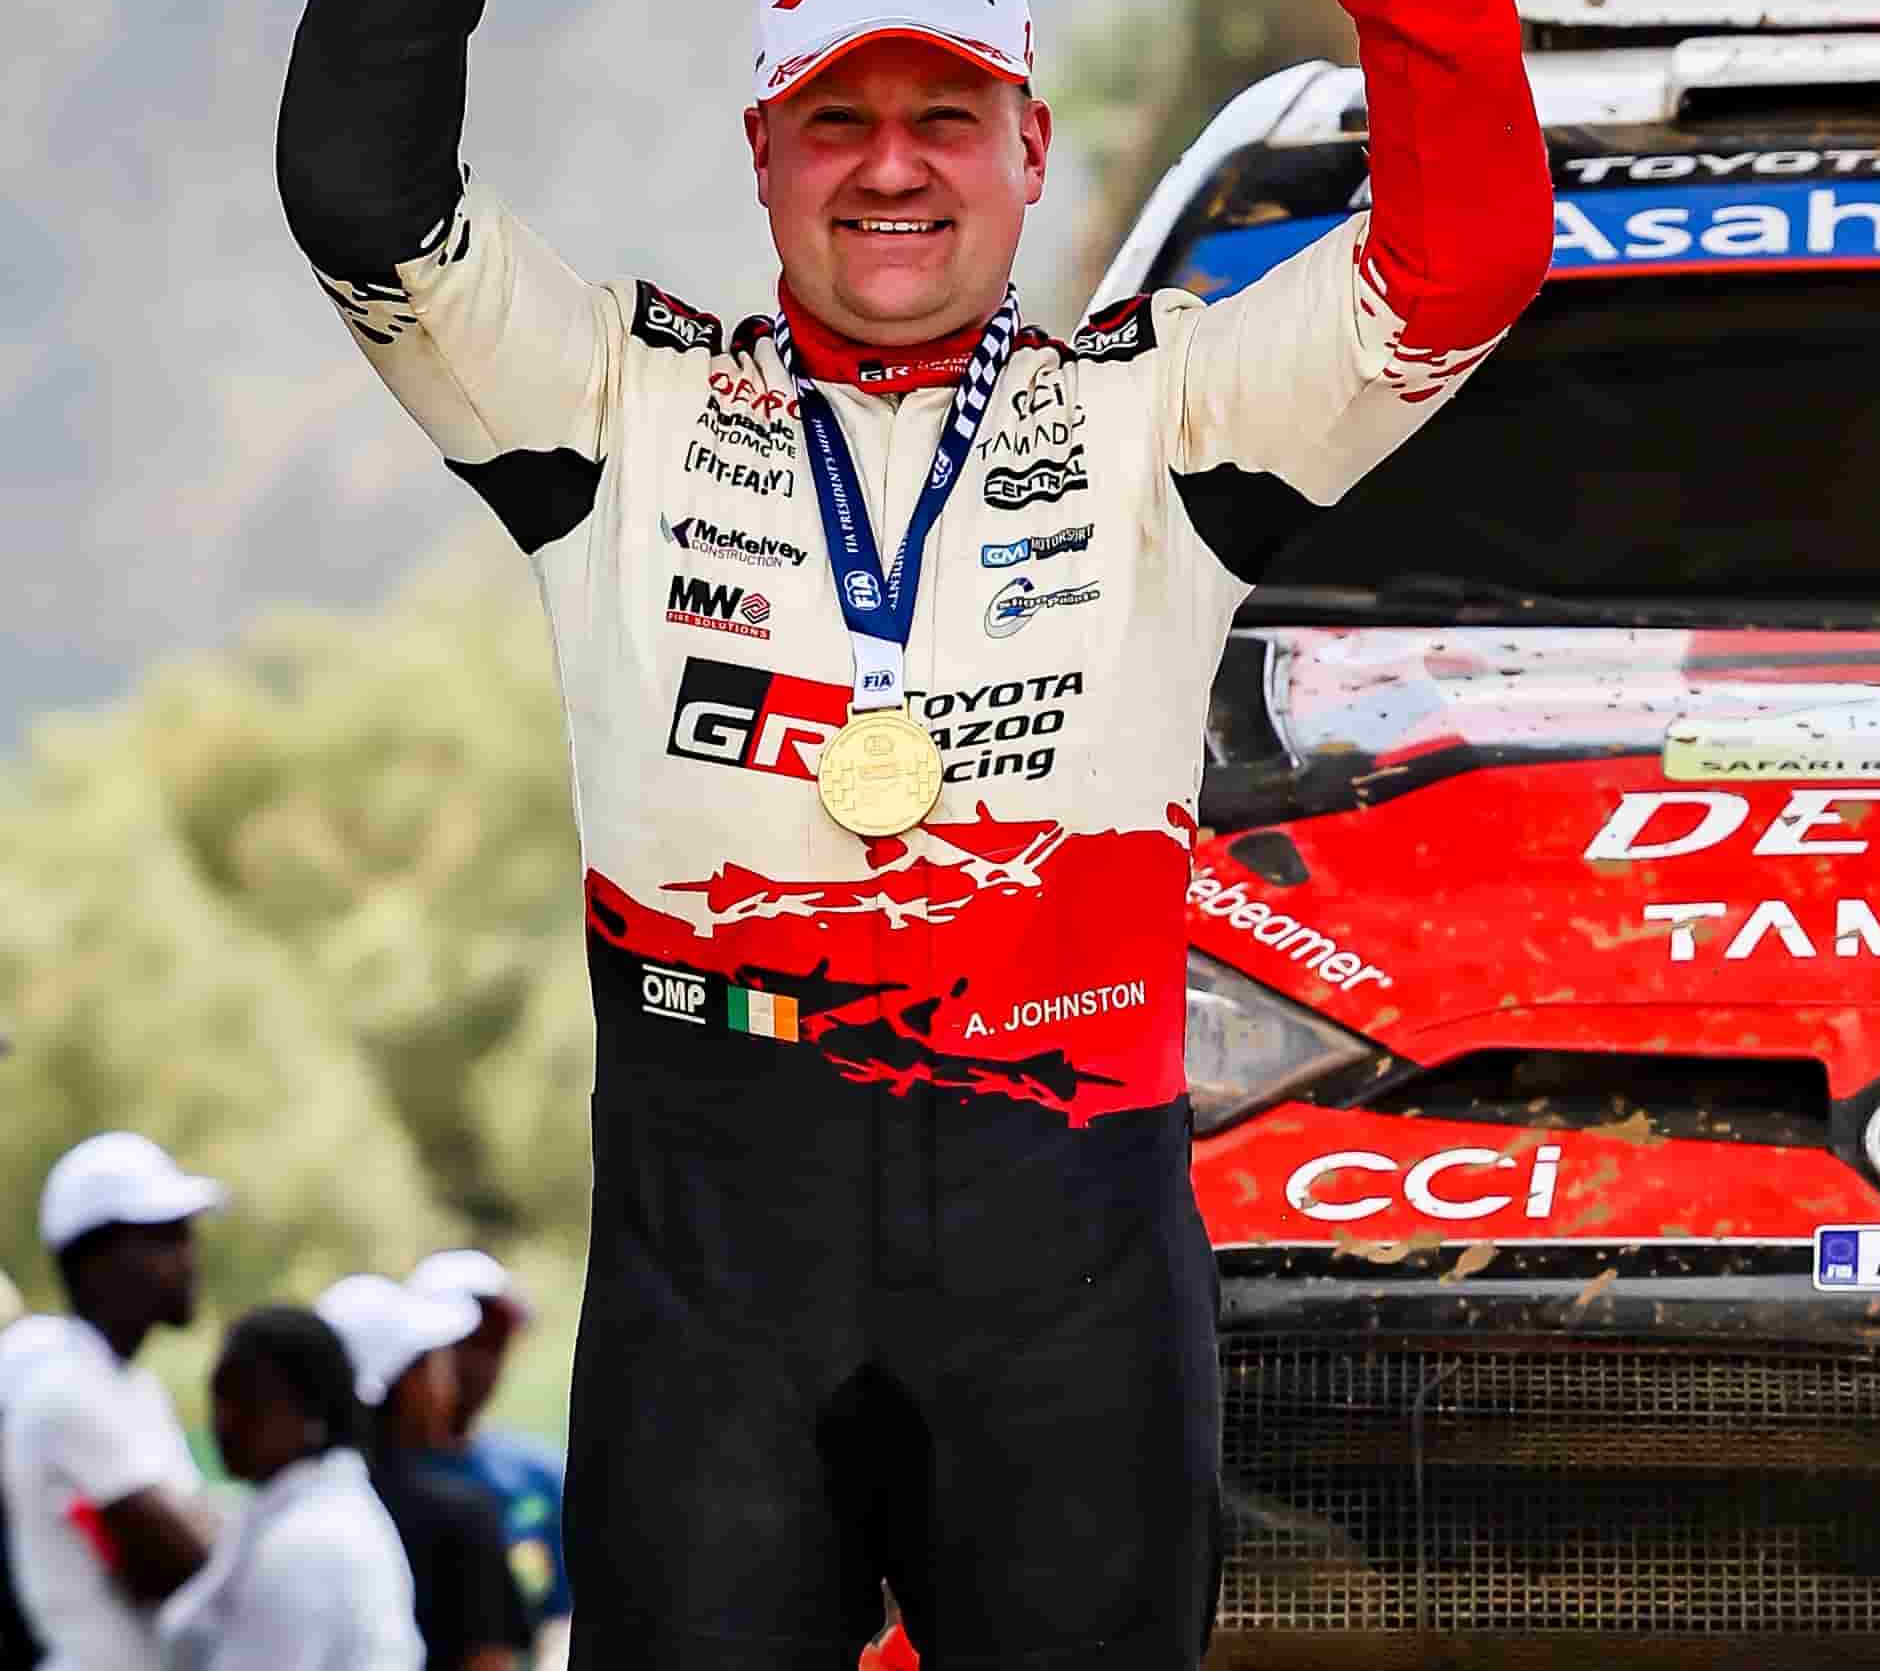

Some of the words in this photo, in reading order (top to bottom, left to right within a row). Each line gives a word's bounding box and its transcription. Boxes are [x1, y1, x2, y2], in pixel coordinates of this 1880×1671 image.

[860, 365, 910, 383] GR
[976, 405, 1086, 461] TAMADC
[691, 539, 784, 569] CONSTRUCTION
[694, 519, 809, 567] McKelvey
[668, 575, 745, 619] MW
[850, 573, 877, 609] FIA
[698, 615, 770, 640] SOLUTIONS
[863, 672, 892, 689] FIA
[674, 700, 839, 780] GR
[930, 709, 1065, 750] AZOO
[944, 746, 1056, 785] cing
[1699, 758, 1846, 774] SAFARI
[1186, 866, 1386, 992] ebeamer
[642, 975, 706, 1016] OMP
[962, 1011, 997, 1040] A.
[1002, 979, 1146, 1034] JOHNSTON
